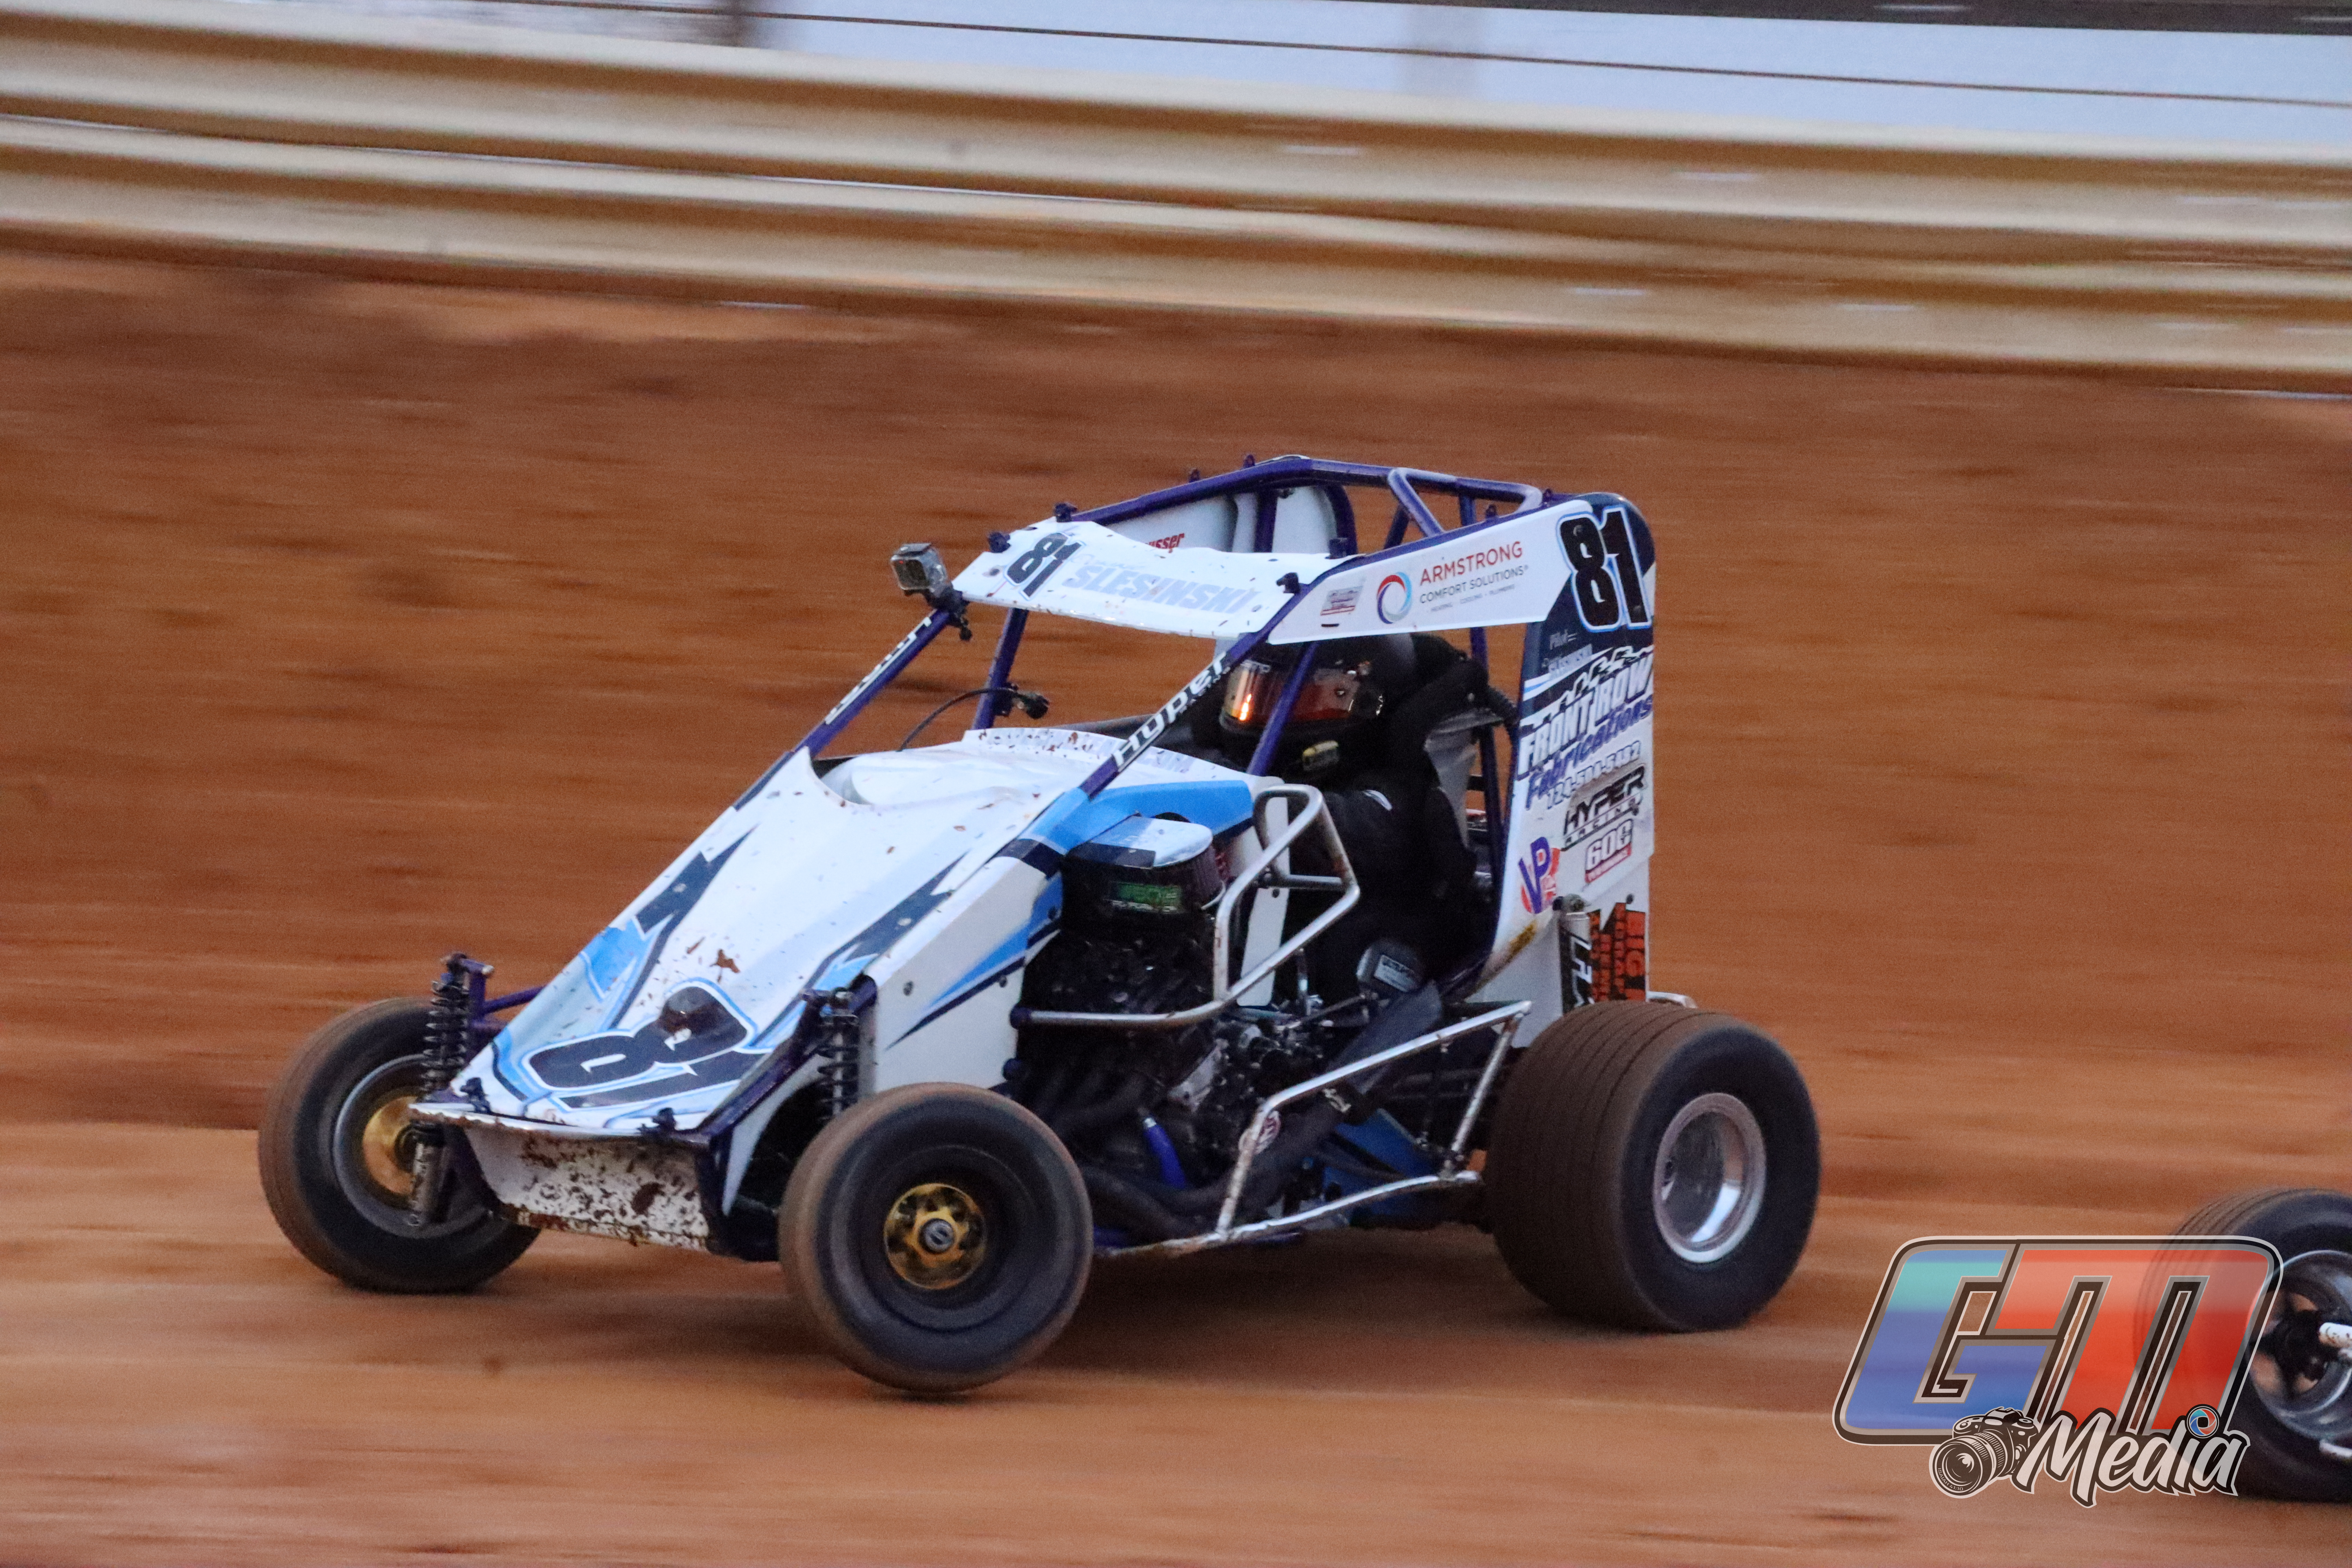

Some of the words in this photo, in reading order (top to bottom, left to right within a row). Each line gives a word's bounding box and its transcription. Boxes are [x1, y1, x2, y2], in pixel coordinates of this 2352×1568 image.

[1008, 532, 1082, 597] 81
[1062, 566, 1260, 614] SLESINSKI
[1420, 541, 1522, 586] ARMSTRONG
[1420, 582, 1467, 604] COMFORT
[1559, 509, 1650, 628] 81
[1114, 651, 1226, 767] Hyper
[1517, 689, 1595, 778] FRONT
[1564, 766, 1645, 836] HYPER
[1518, 837, 1550, 914] VP
[528, 985, 775, 1109] 81
